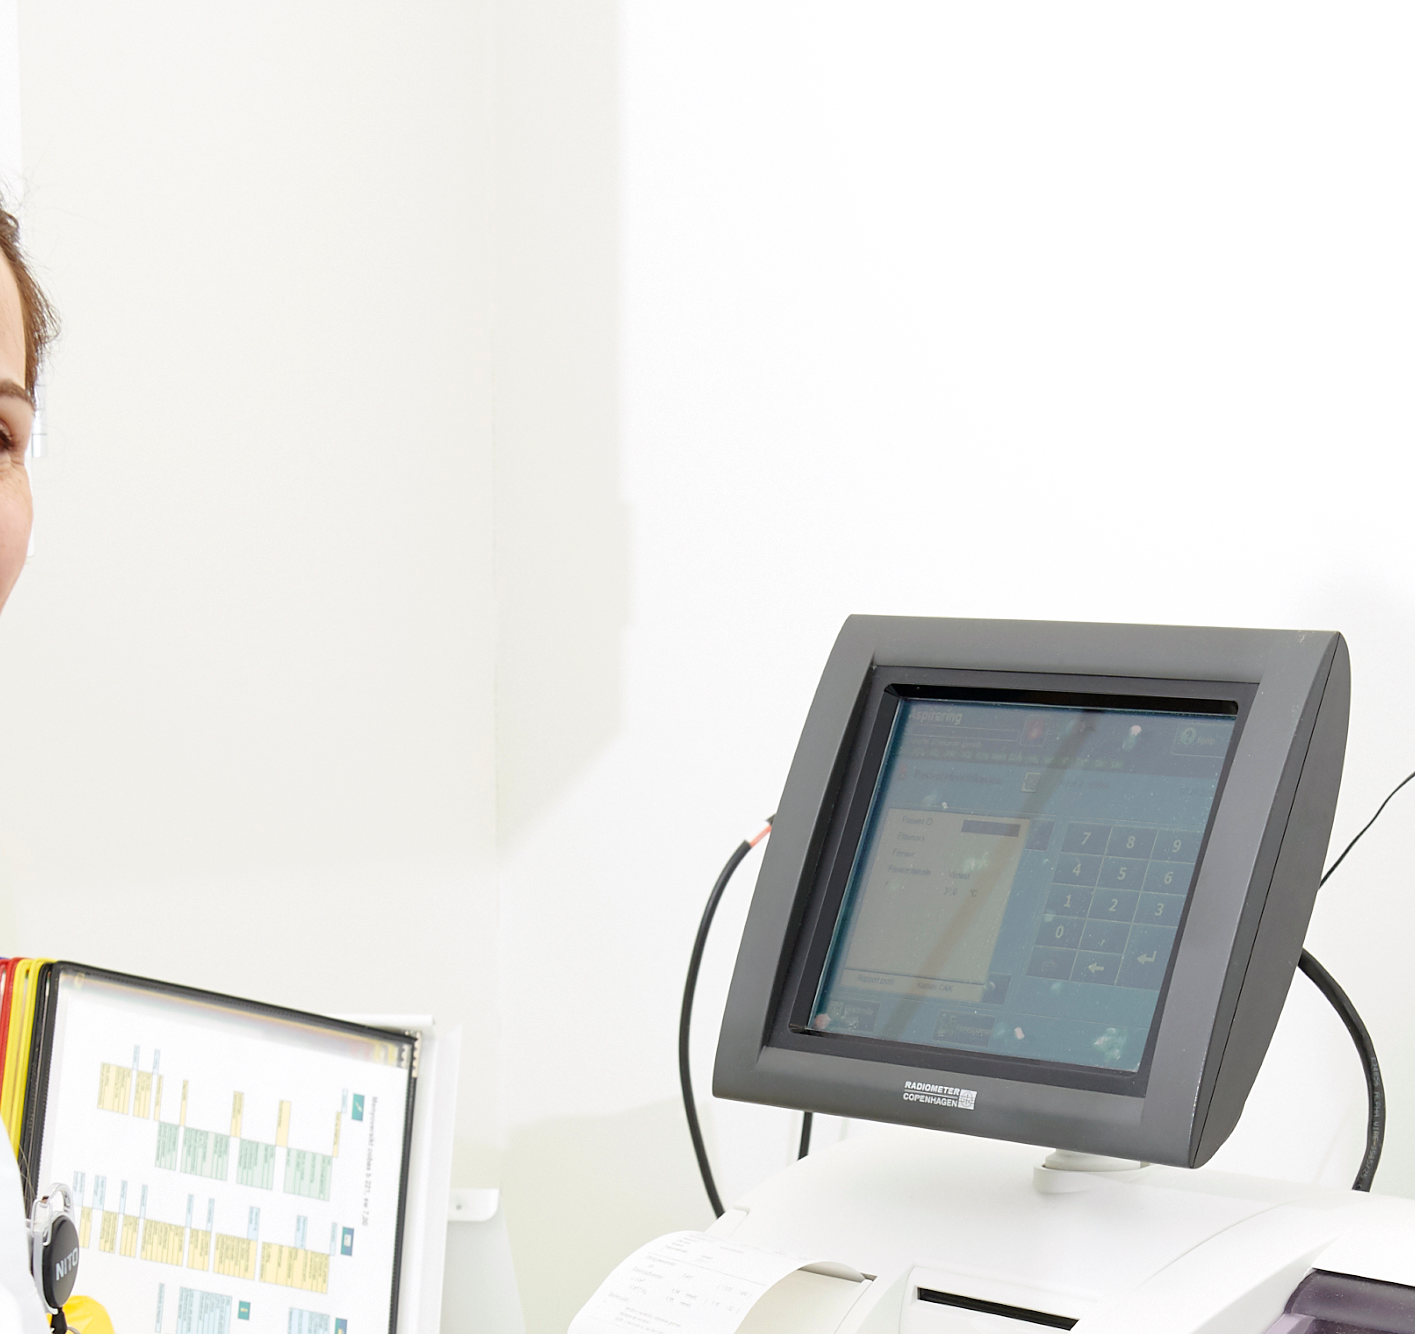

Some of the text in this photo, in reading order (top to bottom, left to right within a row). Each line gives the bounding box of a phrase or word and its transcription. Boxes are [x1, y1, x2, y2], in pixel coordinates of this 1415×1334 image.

[1081, 832, 1091, 845] 7
[1126, 836, 1136, 849] 8
[1172, 839, 1181, 853] 9
[1073, 863, 1082, 876] 4
[1117, 867, 1127, 880] 5
[1164, 871, 1174, 884] 6
[1064, 894, 1072, 908] 1
[1109, 898, 1118, 912] 2
[1154, 903, 1164, 916] 3
[1055, 925, 1064, 938] 0
[904, 1080, 960, 1096] RADIOMETER
[902, 1093, 958, 1108] COPENHAGEN
[56, 1247, 79, 1281] NITO
